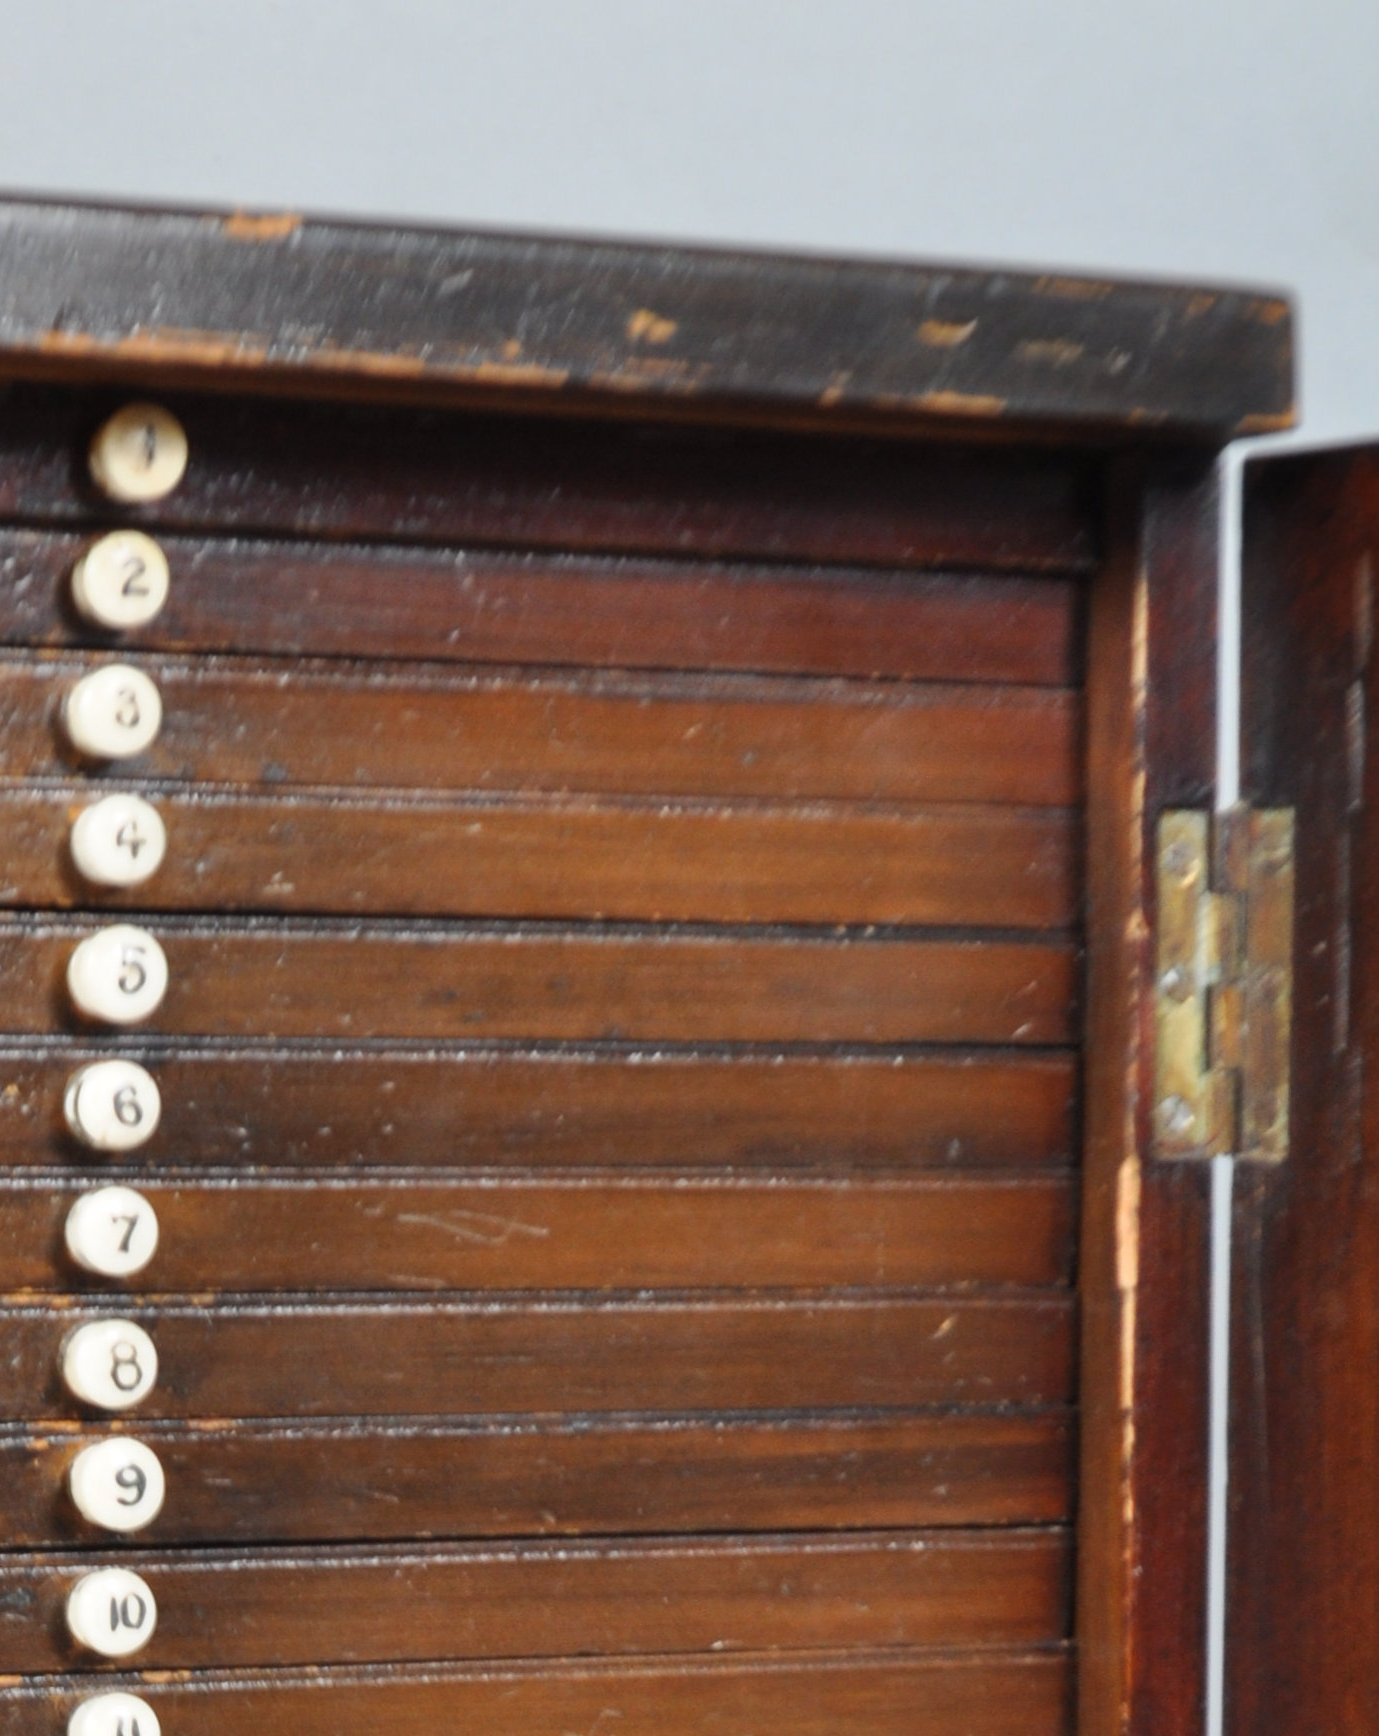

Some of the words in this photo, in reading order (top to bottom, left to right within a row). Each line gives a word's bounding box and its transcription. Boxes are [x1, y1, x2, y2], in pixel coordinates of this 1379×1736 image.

[141, 425, 155, 471] 1
[121, 557, 149, 596] 2
[114, 688, 140, 727] 3
[116, 819, 146, 860] 4
[118, 946, 147, 994] 5
[113, 1086, 143, 1125] 6
[111, 1215, 139, 1253] 7
[110, 1342, 143, 1391] 8
[115, 1463, 147, 1506] 9
[110, 1593, 147, 1632] 10
